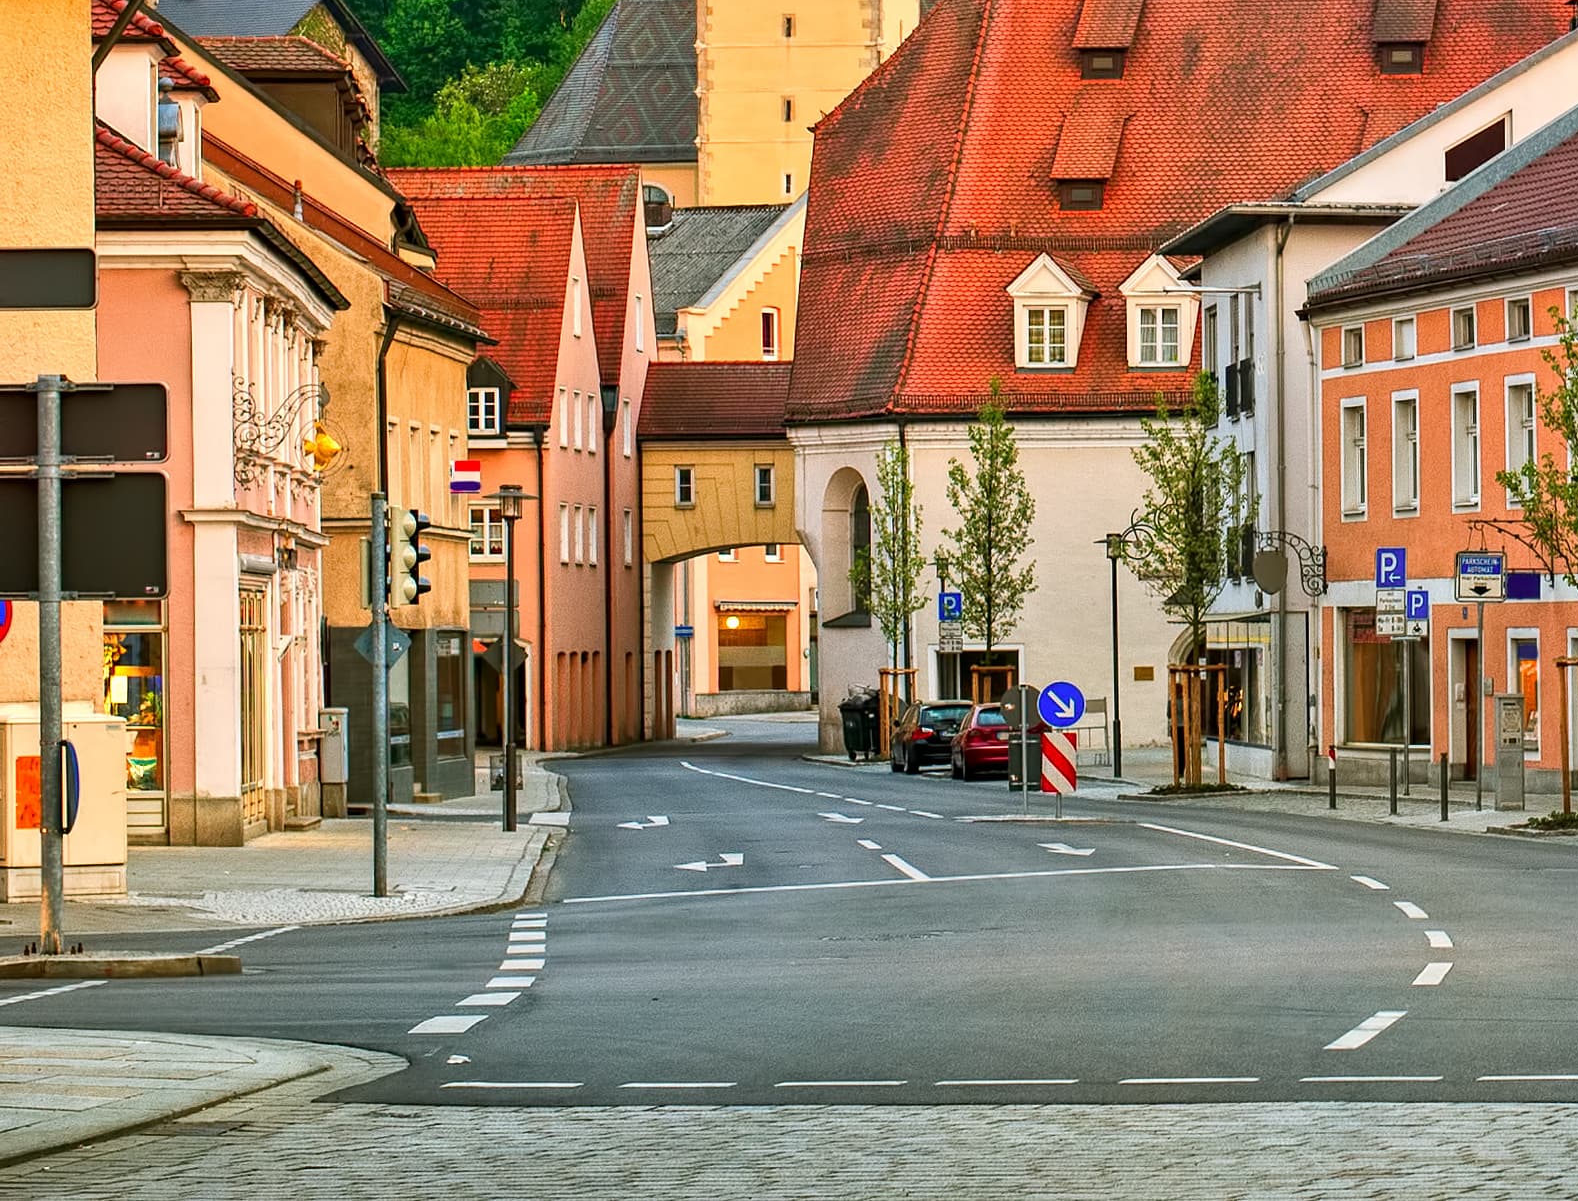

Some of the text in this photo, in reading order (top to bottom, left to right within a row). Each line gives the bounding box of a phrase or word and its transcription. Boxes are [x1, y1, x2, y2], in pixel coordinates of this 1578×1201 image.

[1381, 552, 1397, 584] P
[944, 596, 956, 617] P
[1412, 594, 1424, 616] P
